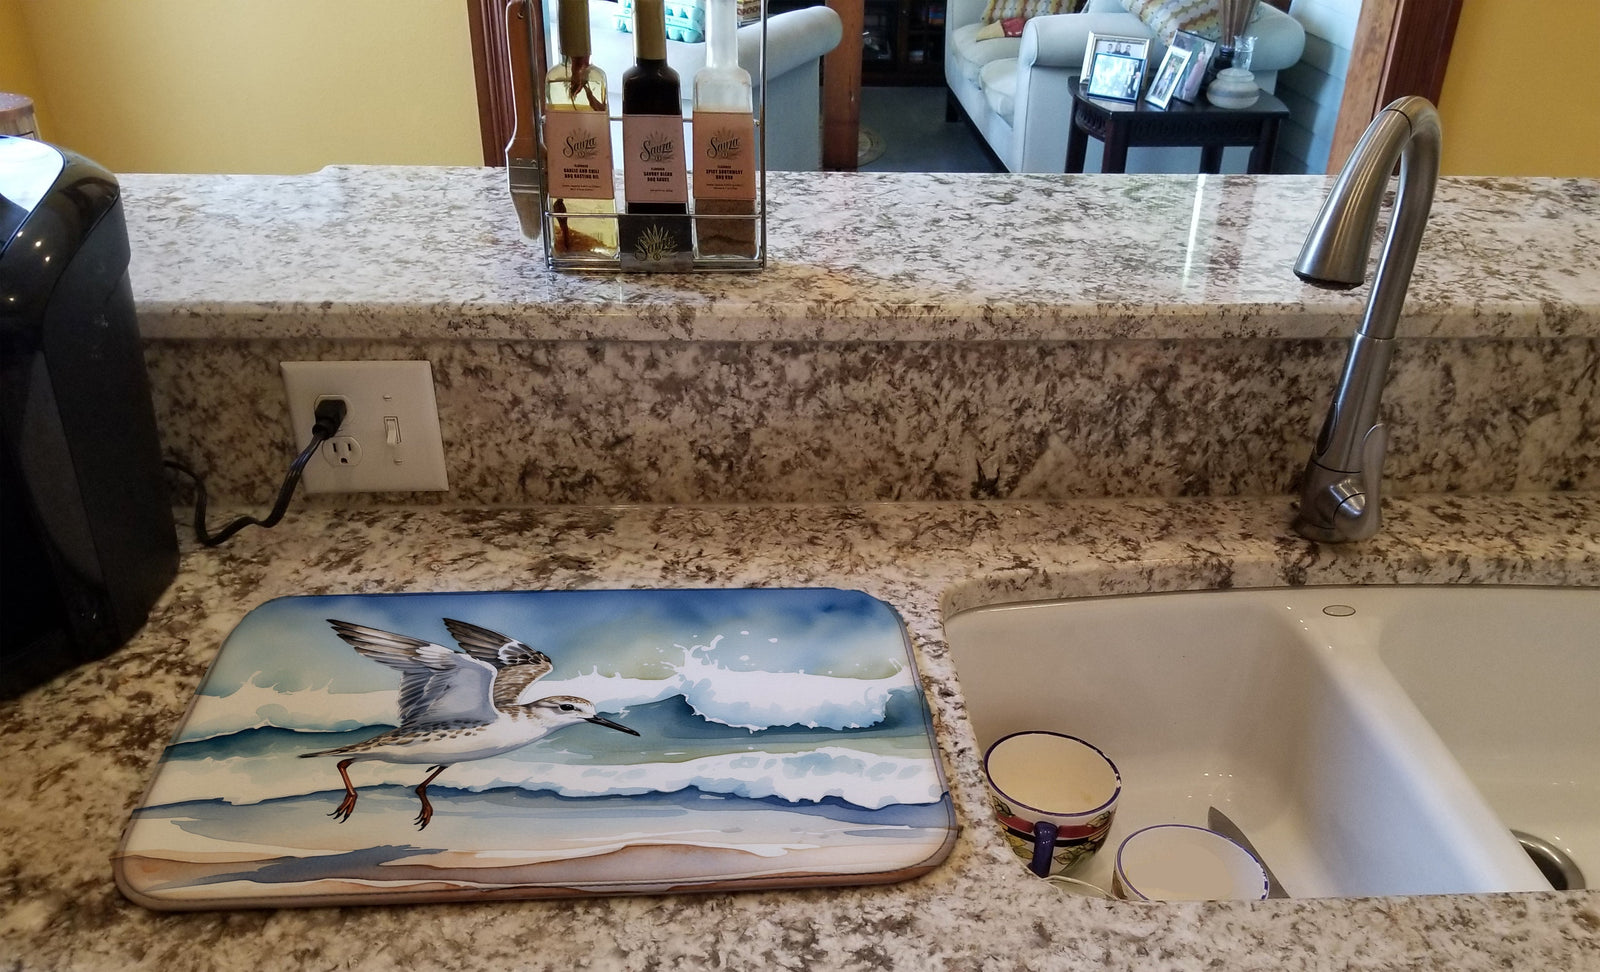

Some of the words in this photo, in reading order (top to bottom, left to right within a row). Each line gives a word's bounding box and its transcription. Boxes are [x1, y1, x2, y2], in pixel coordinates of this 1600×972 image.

[563, 136, 597, 158] Sauza
[640, 140, 673, 162] Sauza
[707, 136, 739, 159] Sauza
[635, 236, 673, 261] Sauza
